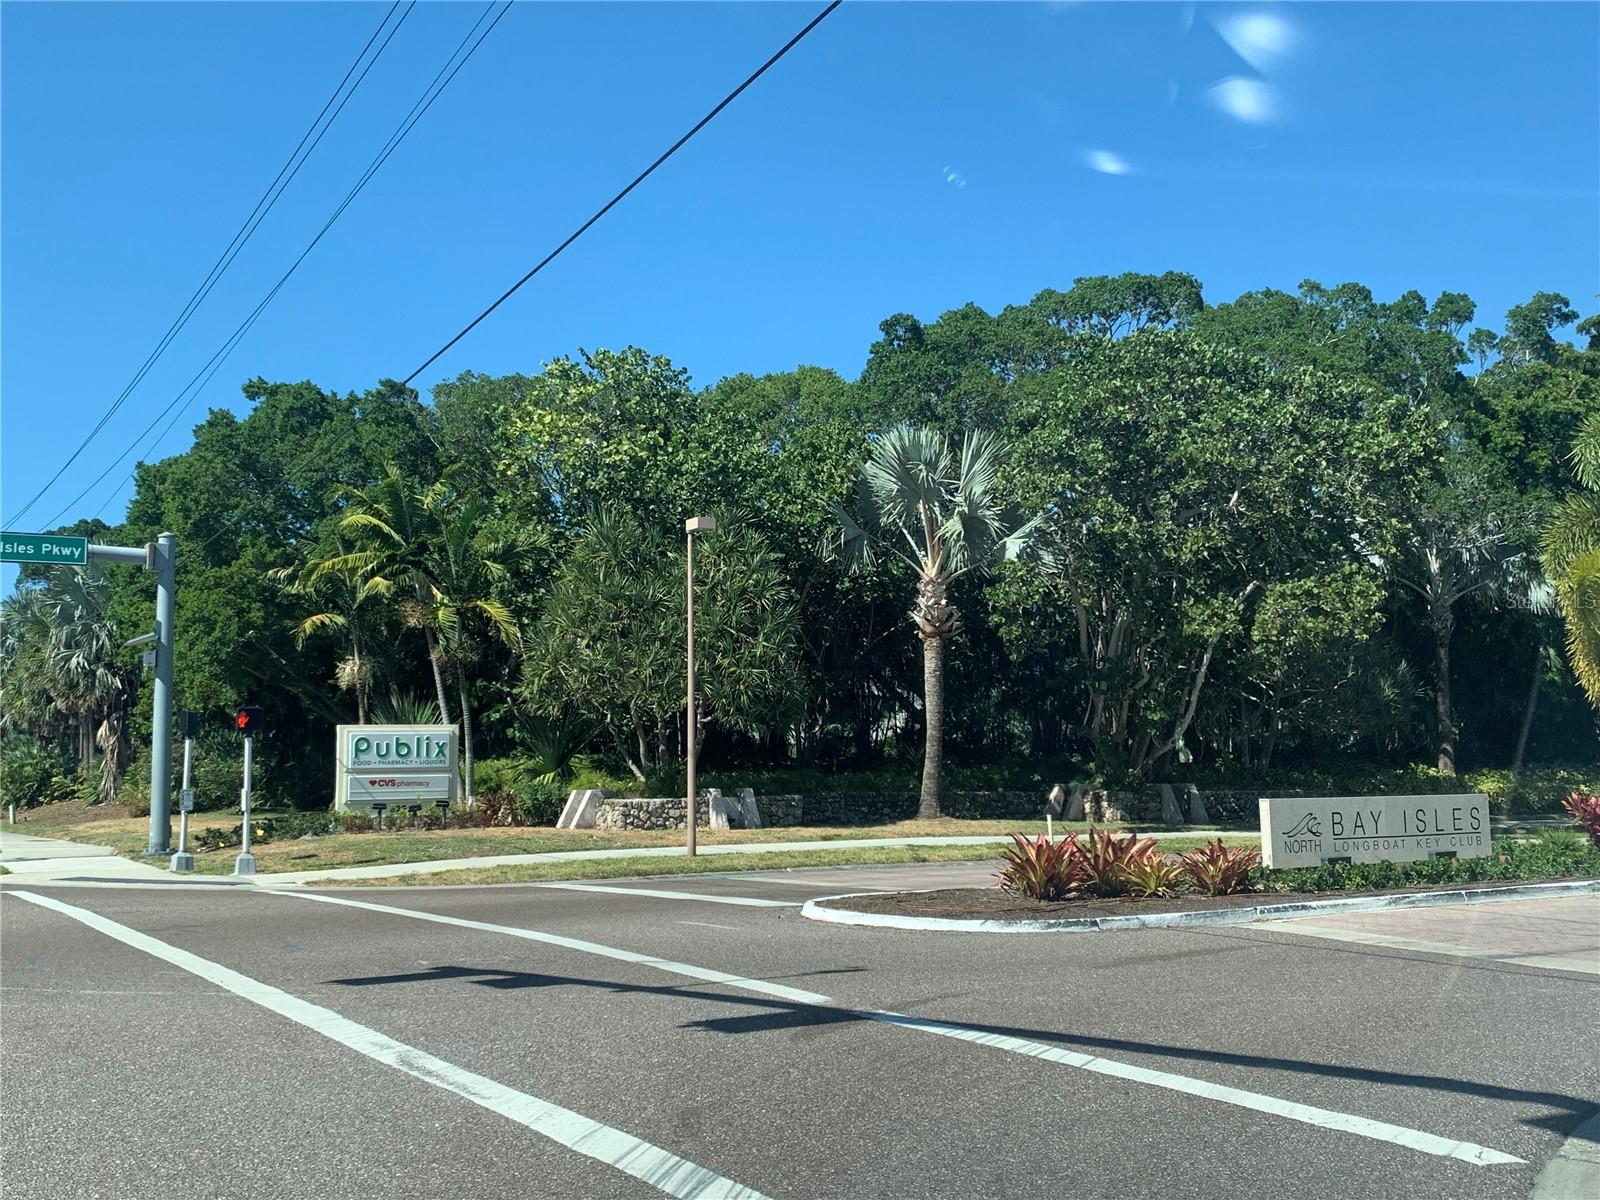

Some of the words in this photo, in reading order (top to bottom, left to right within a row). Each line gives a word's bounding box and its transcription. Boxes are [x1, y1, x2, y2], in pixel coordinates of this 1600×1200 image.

[0, 542, 34, 554] Isles
[41, 543, 82, 559] Pkwy
[353, 735, 448, 758] Publix
[378, 779, 396, 787] CVS
[397, 780, 430, 788] pharmacy
[1331, 811, 1382, 837] BAY
[1403, 806, 1482, 834] ISLES
[1284, 839, 1322, 854] NORTH
[1333, 839, 1406, 853] LONGBOAT
[1416, 837, 1441, 848] KEY
[1449, 835, 1483, 847] CLUB
